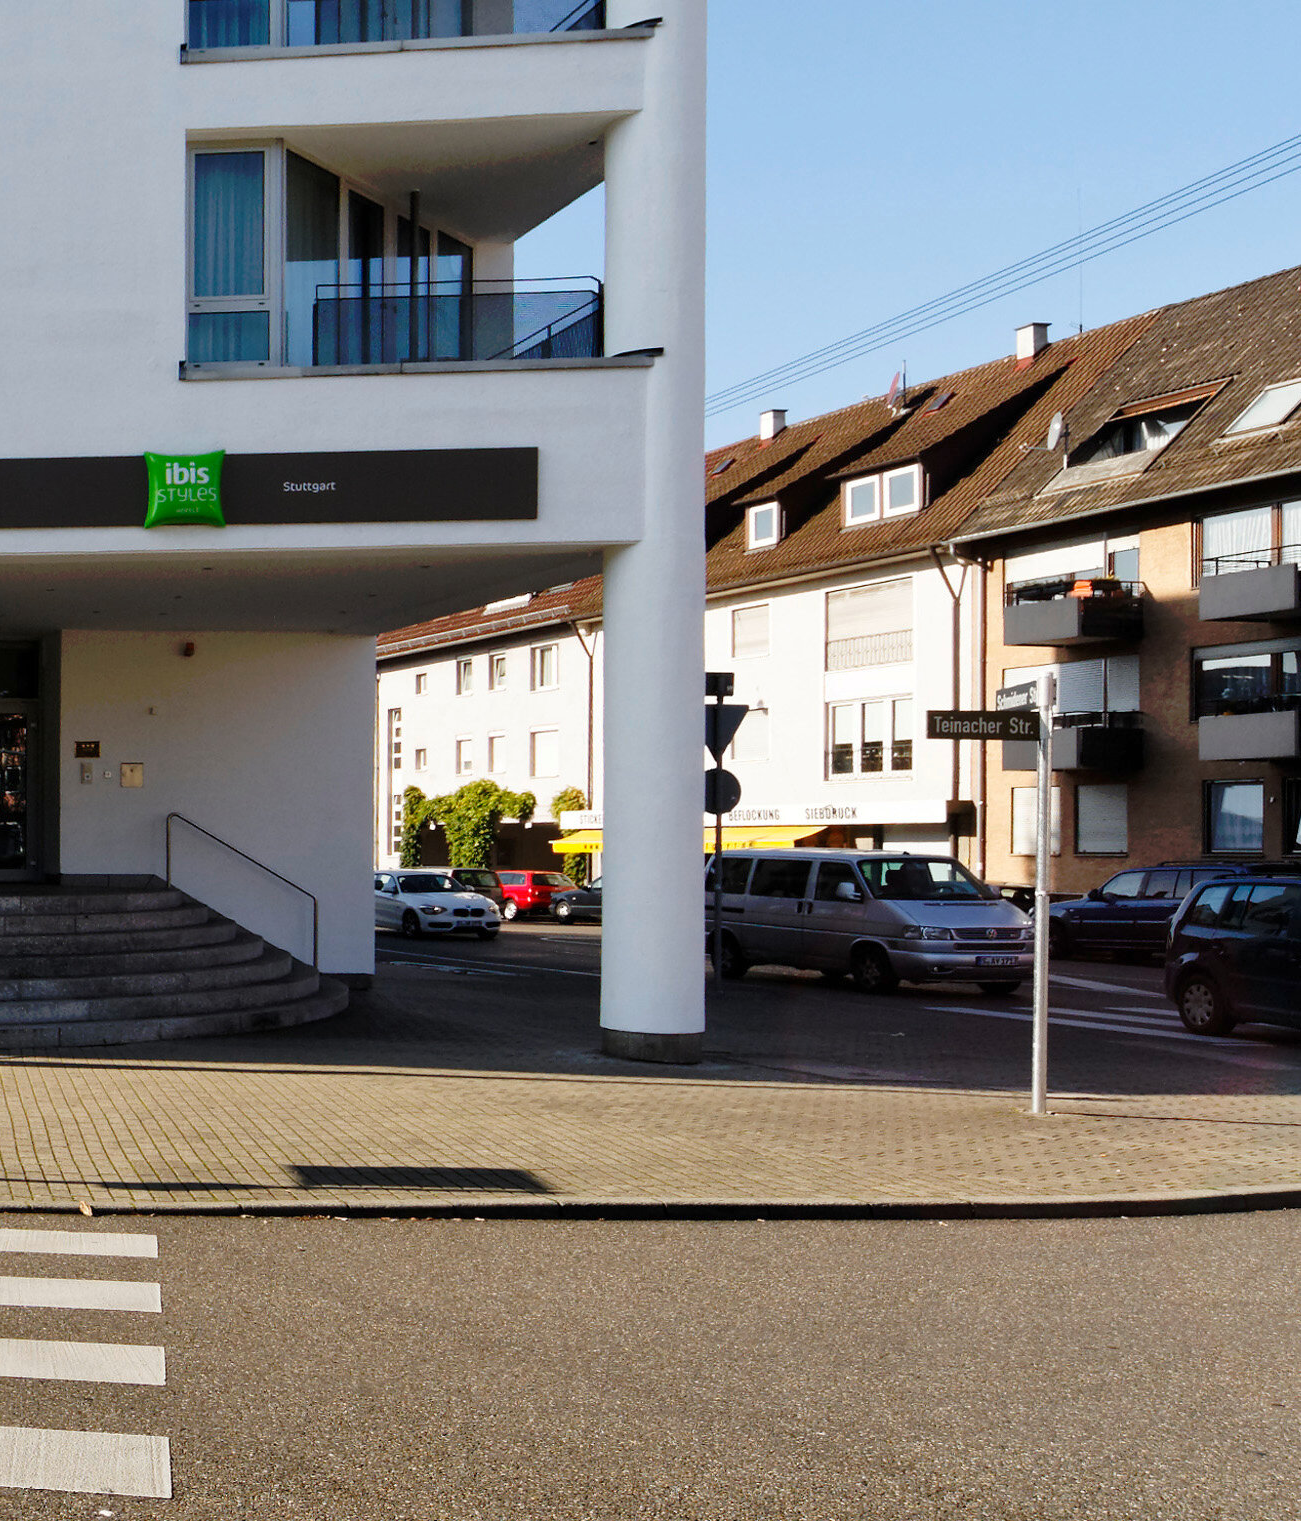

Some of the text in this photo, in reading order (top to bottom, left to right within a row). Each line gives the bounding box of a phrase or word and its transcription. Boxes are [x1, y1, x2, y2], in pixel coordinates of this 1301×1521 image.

[165, 462, 210, 485] ibis
[283, 481, 337, 493] Stuttgart
[933, 716, 1034, 734] Teinacher Str.
[729, 808, 780, 821] BEFLOCKUNG
[805, 806, 857, 820] SIEBDRUCK
